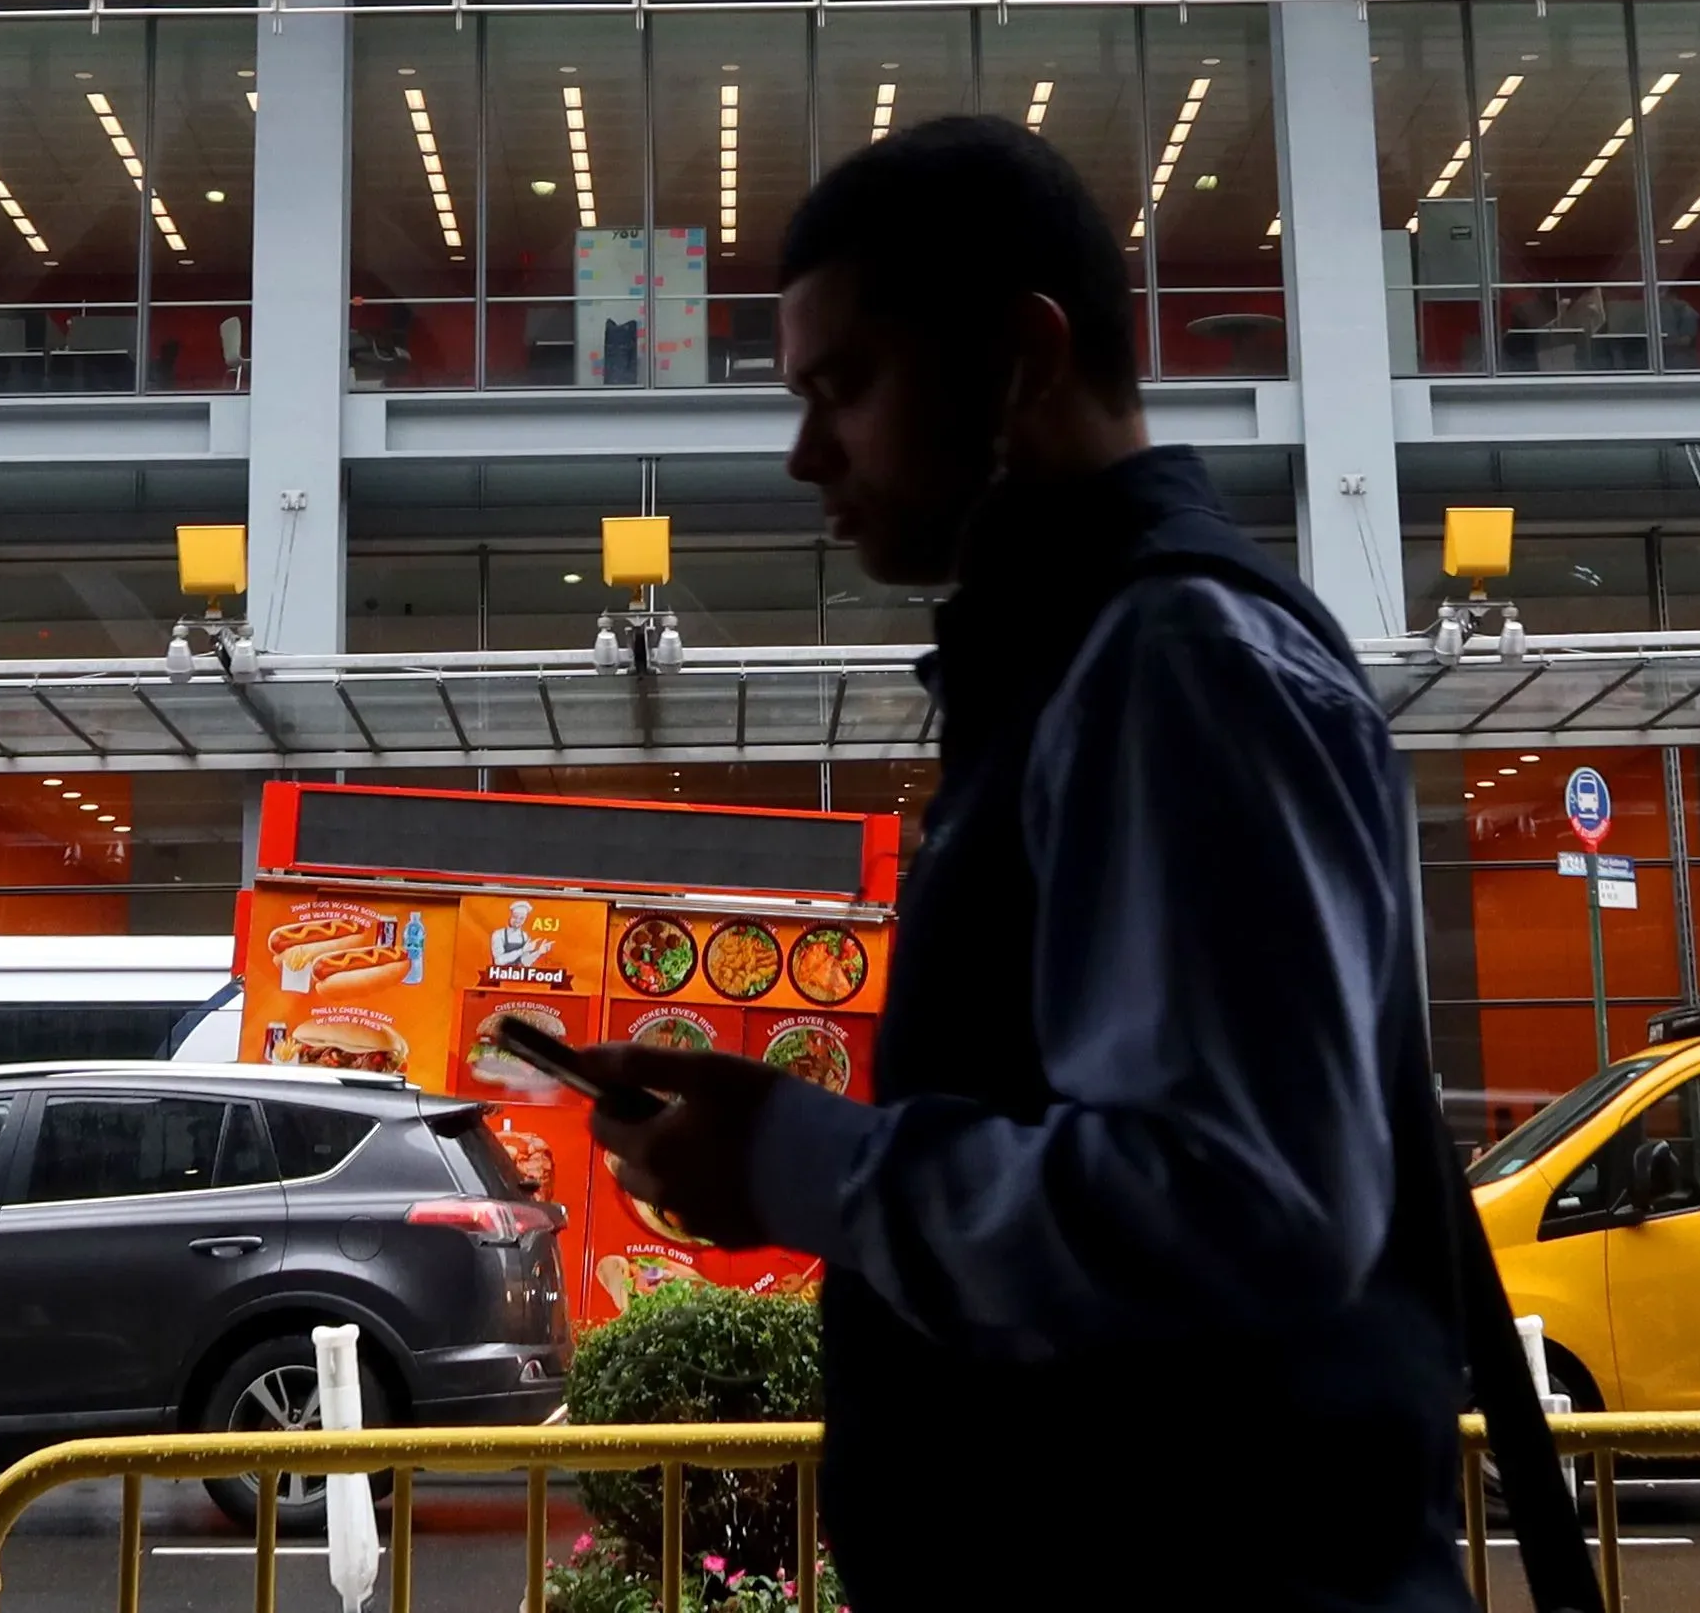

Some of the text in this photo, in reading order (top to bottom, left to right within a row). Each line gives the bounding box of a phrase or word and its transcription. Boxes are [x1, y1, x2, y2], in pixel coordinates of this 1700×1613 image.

[532, 918, 560, 932] ASJ
[489, 966, 563, 983] Halal Food
[339, 1007, 369, 1017] CHEESE
[628, 1007, 718, 1040] CHICKEN OVER RICE
[766, 1016, 849, 1041] LAMB OVER RICE
[626, 1244, 694, 1265] FALAFEL GYRO
[755, 1272, 775, 1292] DOG
